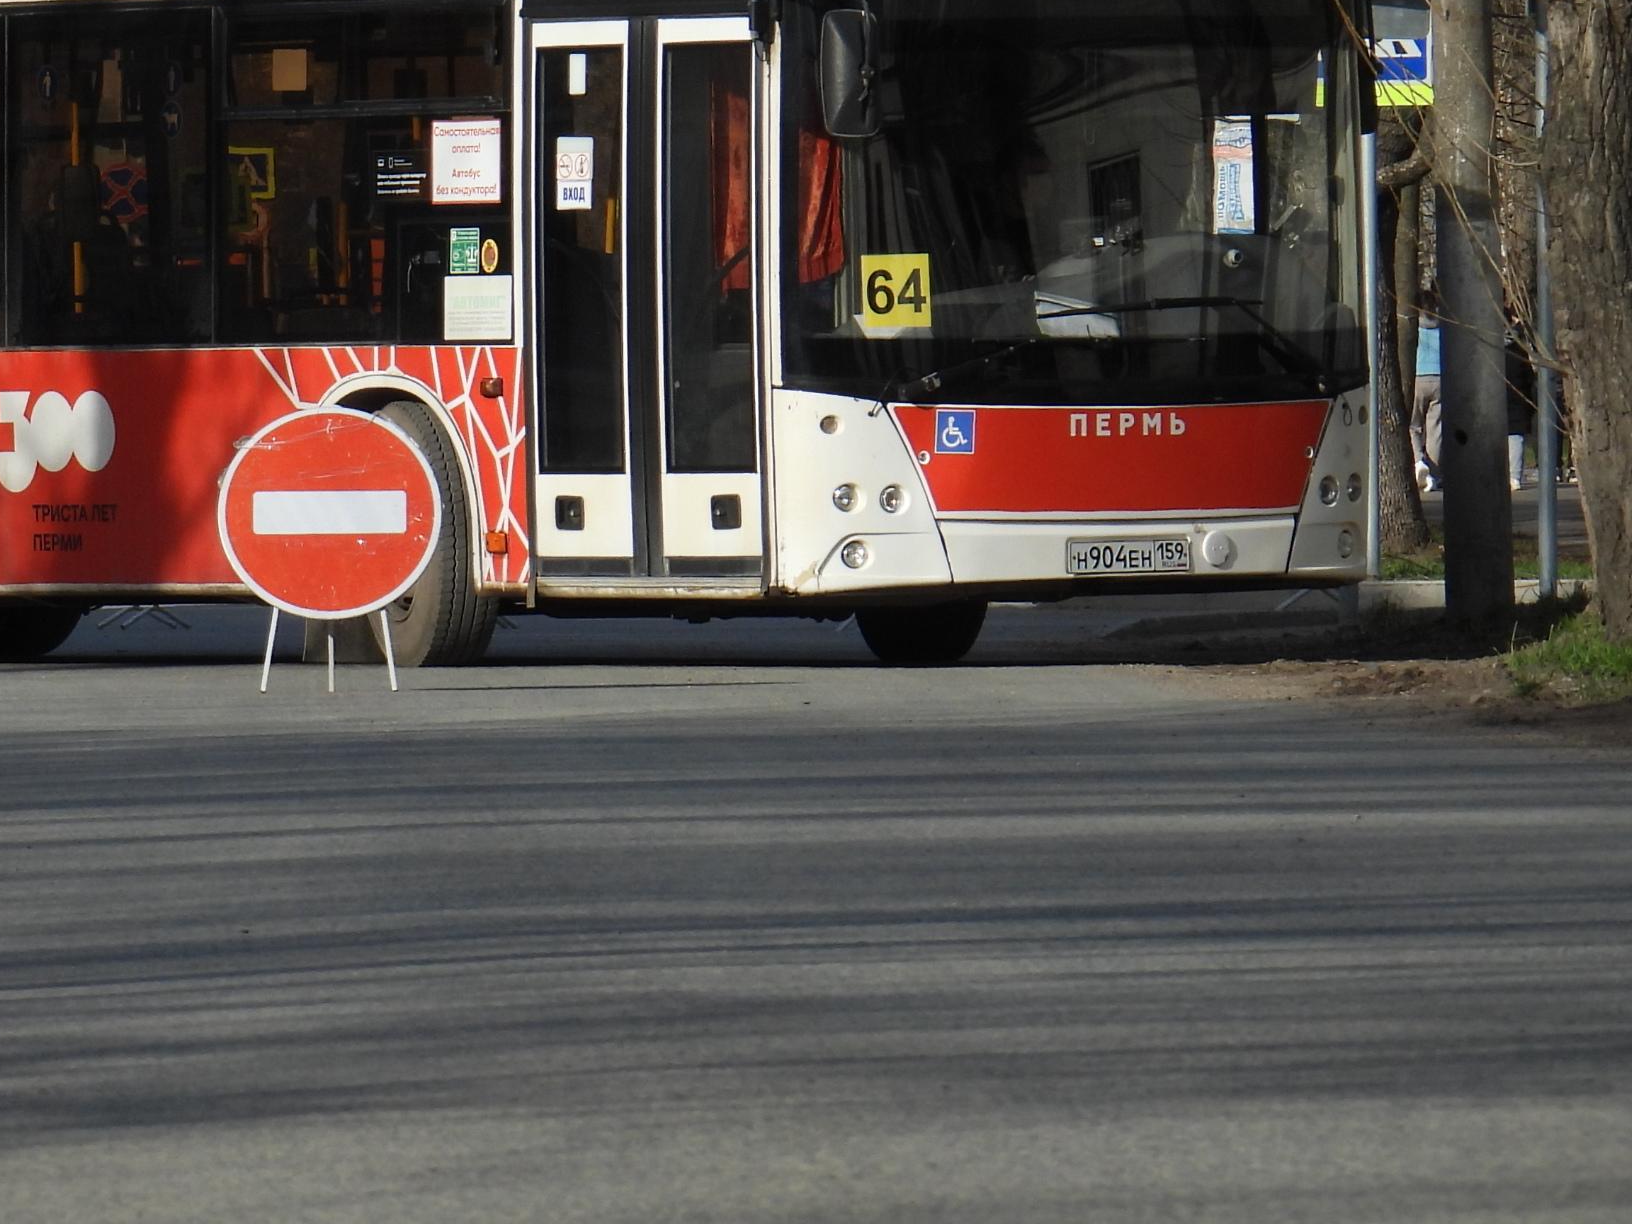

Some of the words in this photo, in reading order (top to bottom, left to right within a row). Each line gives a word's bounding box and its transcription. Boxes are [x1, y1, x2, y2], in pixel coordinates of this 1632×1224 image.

[433, 126, 500, 137] Самостоятельная
[451, 143, 480, 153] оплата!
[451, 168, 480, 179] Автобус
[436, 185, 448, 195] без
[450, 184, 496, 196] кондуктора!
[563, 187, 584, 202] ВХОД
[866, 267, 927, 315] 64
[1070, 412, 1186, 437] ПЕРМЬ
[32, 504, 87, 521] ТРИСТА
[91, 504, 117, 521] ЛЕТ
[33, 533, 82, 551] ПЕРМИ
[1156, 542, 1183, 559] 159
